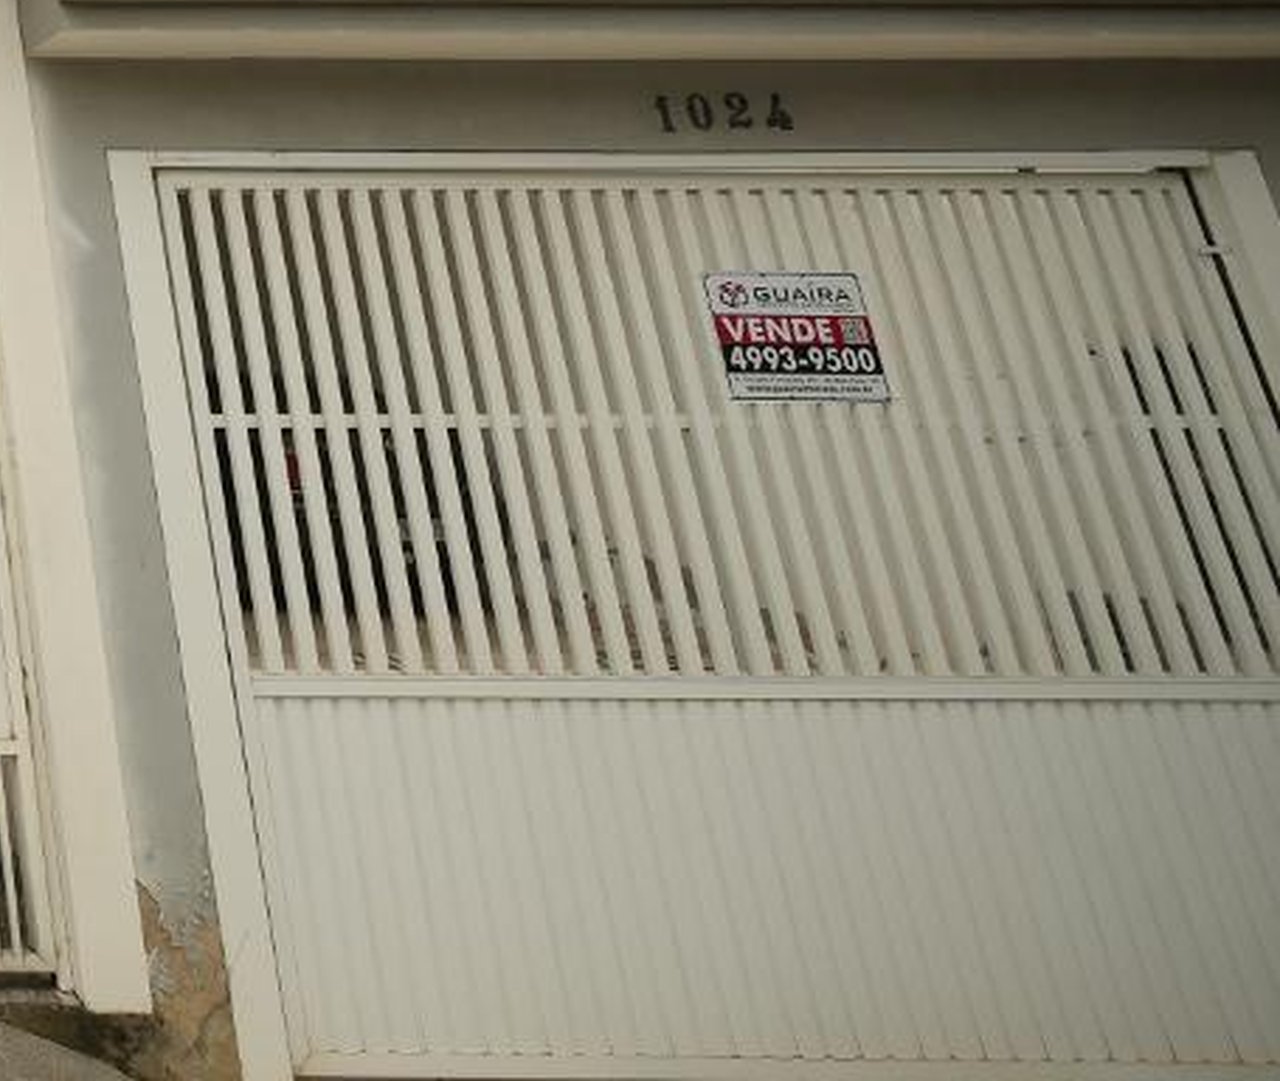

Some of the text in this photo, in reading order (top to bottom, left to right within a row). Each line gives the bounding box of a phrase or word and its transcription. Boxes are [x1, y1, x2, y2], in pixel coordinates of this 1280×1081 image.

[654, 92, 794, 132] 1024
[720, 318, 835, 345] VENDE
[729, 346, 877, 373] 4993-9500
